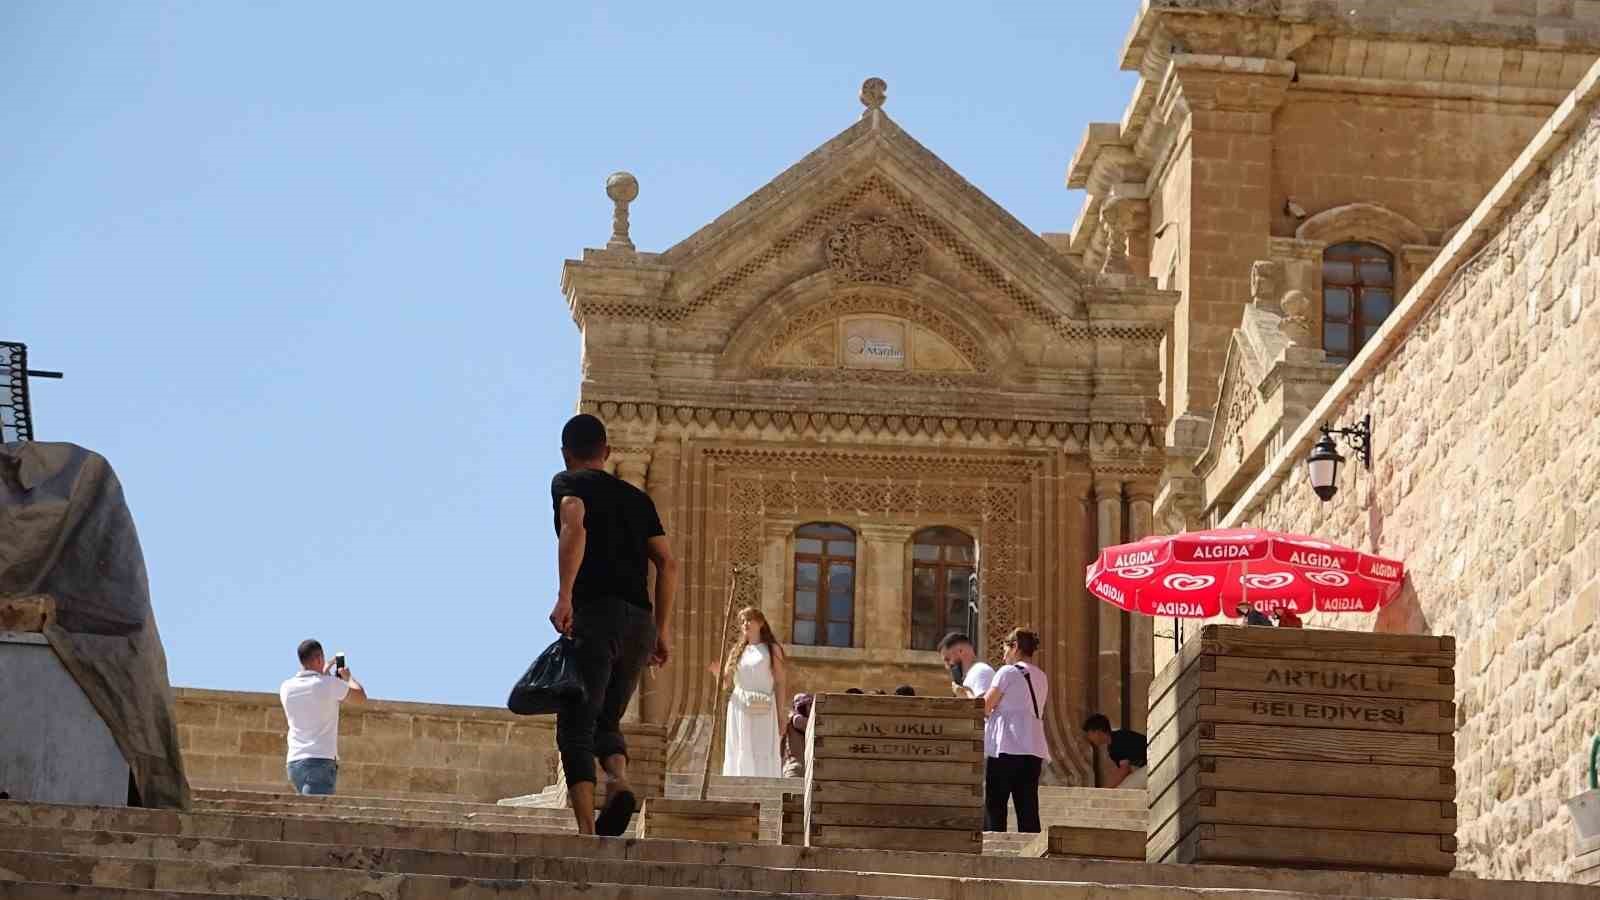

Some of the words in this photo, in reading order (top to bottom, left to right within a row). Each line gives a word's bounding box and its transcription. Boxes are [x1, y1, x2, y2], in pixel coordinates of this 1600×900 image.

[1114, 551, 1155, 567] ALGIDA
[1193, 545, 1249, 558] ALGIDA
[1290, 550, 1341, 569] ALGIDA
[1370, 562, 1397, 578] ALGIDA
[1264, 667, 1393, 692] ARTUKLU
[856, 721, 944, 736] ARUKLU
